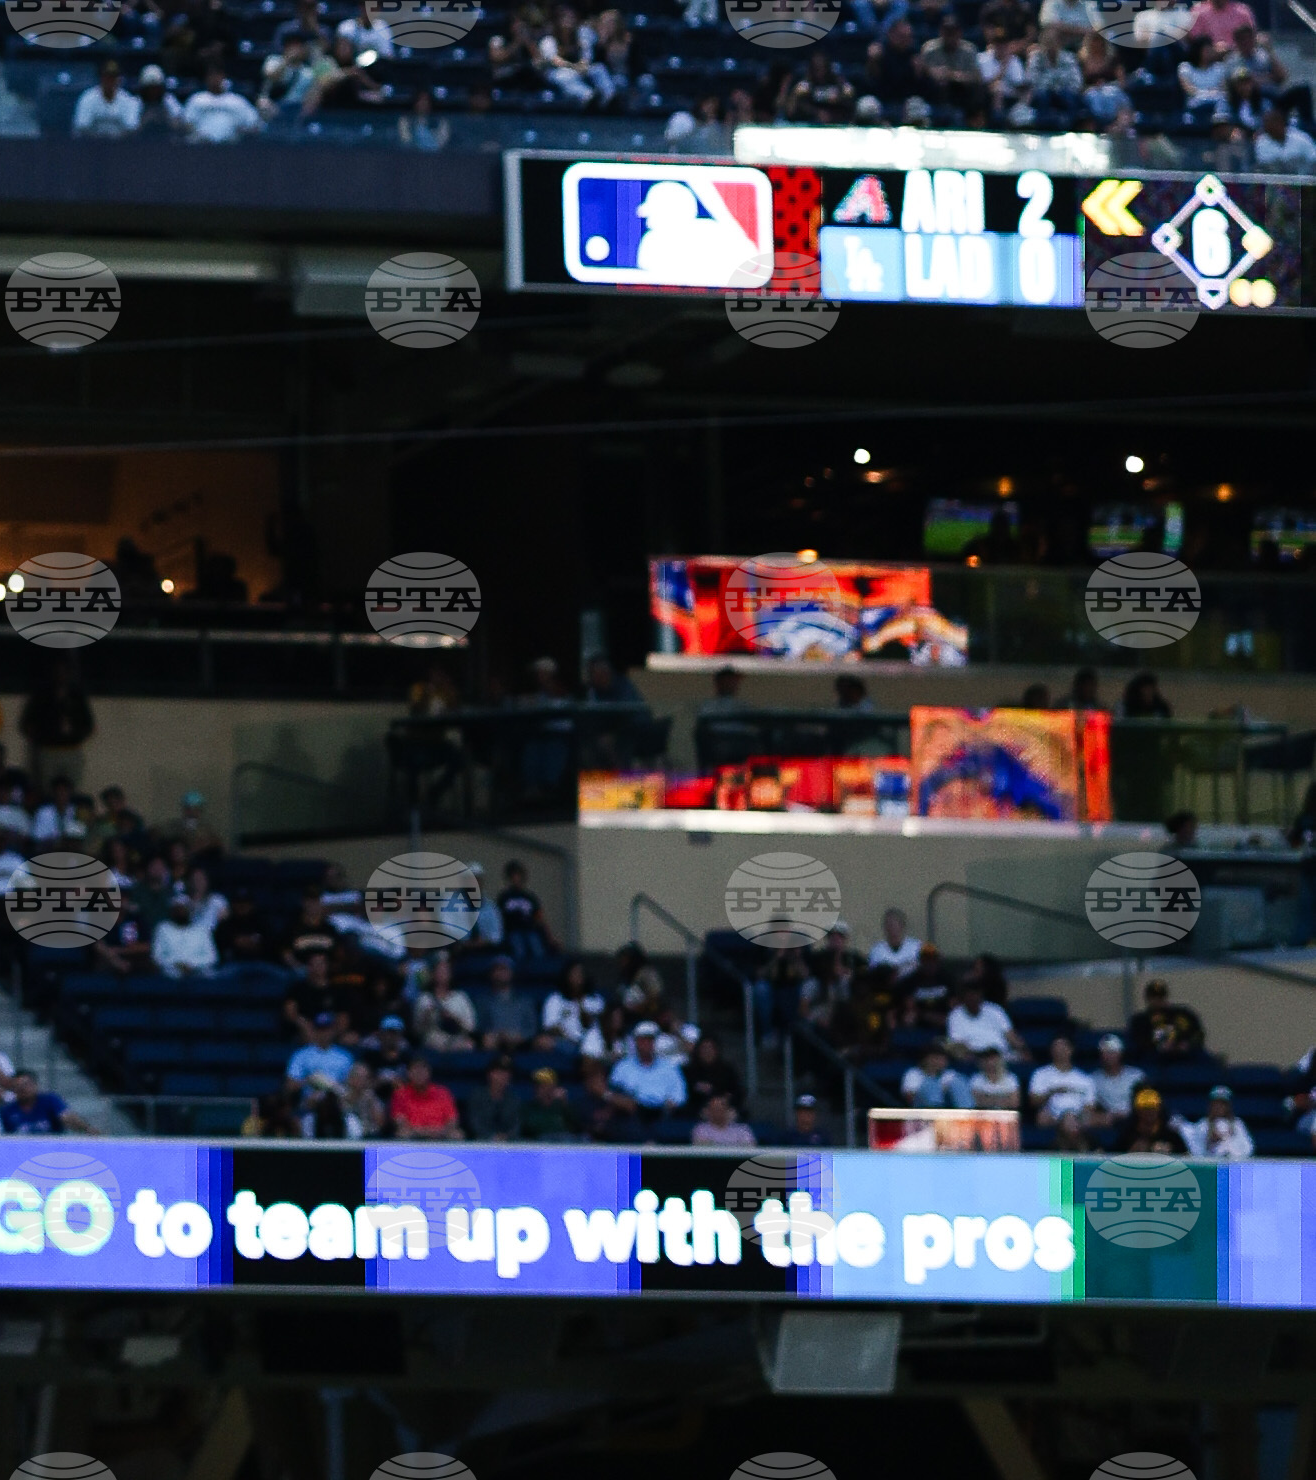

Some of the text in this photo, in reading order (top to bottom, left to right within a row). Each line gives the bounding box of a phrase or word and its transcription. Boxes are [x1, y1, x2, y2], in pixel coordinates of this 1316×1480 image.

[901, 169, 985, 234] ARI
[1017, 170, 1055, 237] 2
[905, 234, 993, 298] LAD
[1019, 238, 1056, 303] 0
[127, 1188, 213, 1258] to
[227, 1189, 429, 1260] team
[446, 1205, 550, 1279] up
[563, 1189, 741, 1266] with
[754, 1190, 885, 1268] the
[903, 1212, 1075, 1284] pros
